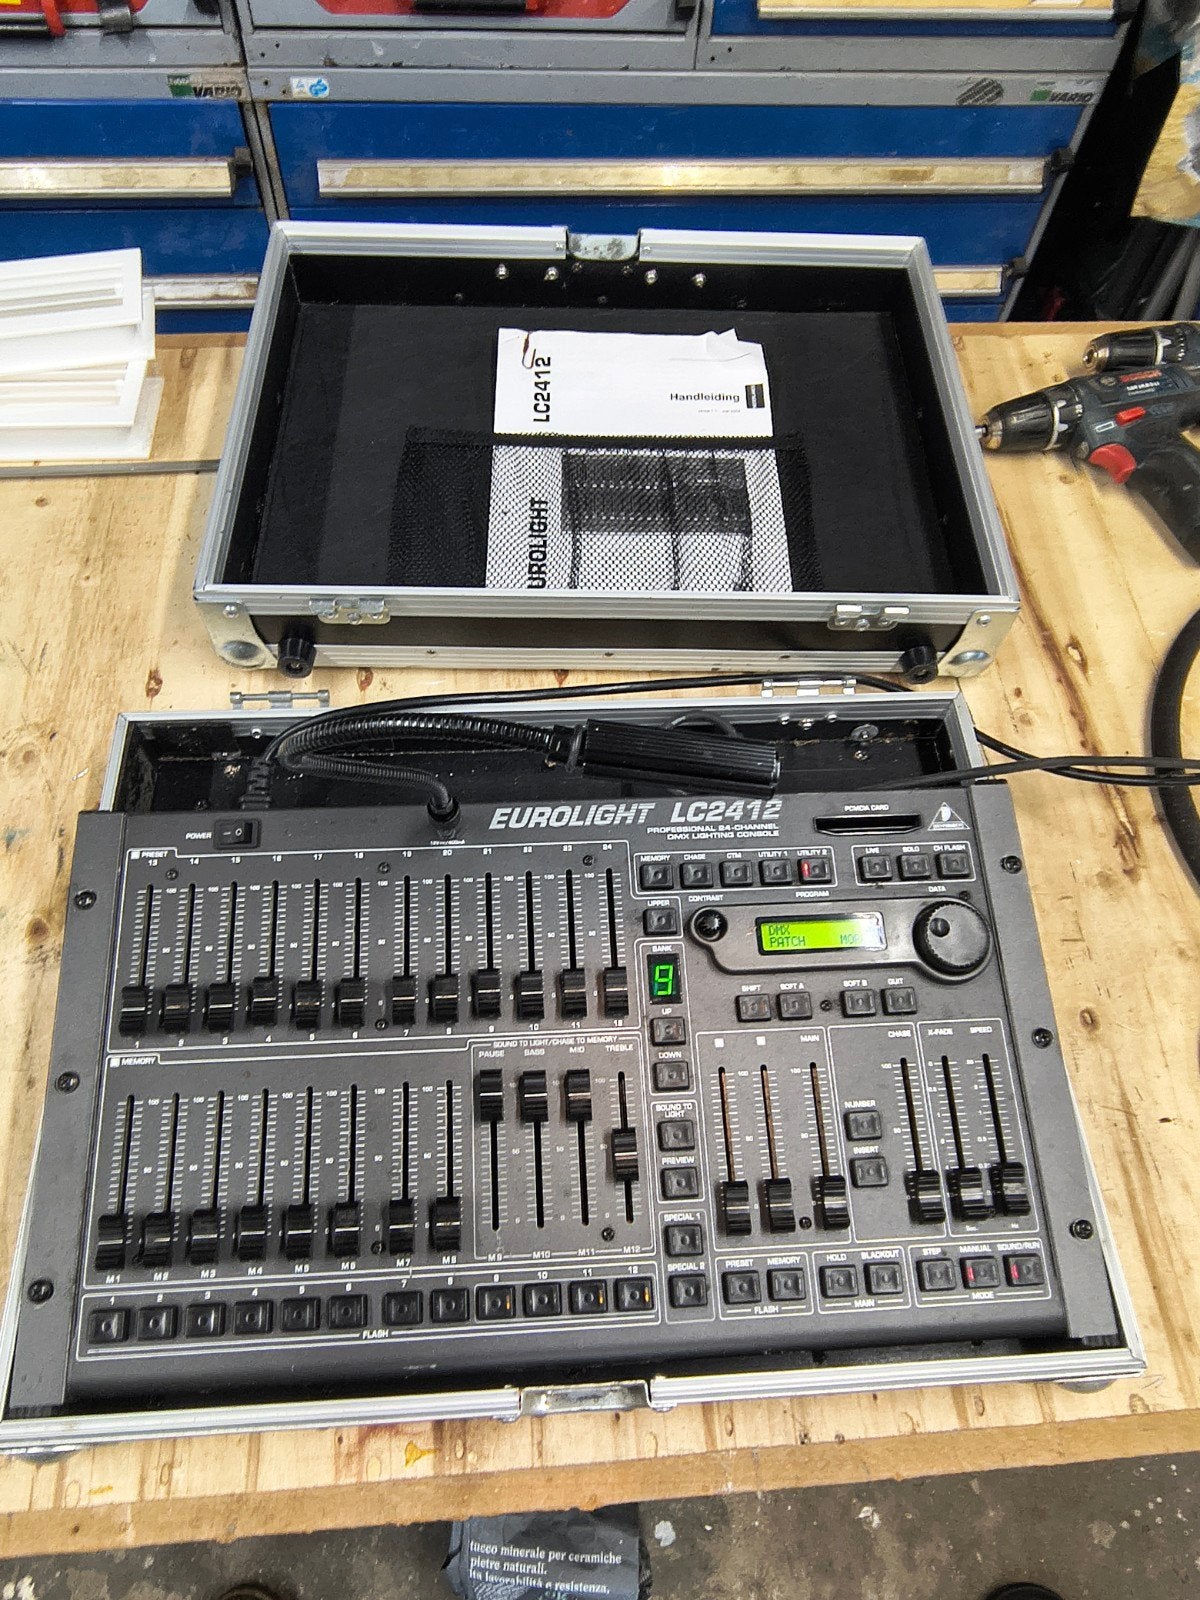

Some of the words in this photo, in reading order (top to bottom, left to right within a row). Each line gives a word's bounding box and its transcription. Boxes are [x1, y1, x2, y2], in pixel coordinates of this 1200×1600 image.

[533, 357, 551, 423] LC2412
[670, 393, 740, 403] Handleiding
[489, 802, 654, 830] EUROLIGHT
[670, 800, 782, 823] LC2412
[647, 825, 716, 834] PROFESSIONAL
[719, 823, 779, 831] 24-CHANNEL
[185, 832, 212, 840] POWER
[737, 830, 779, 838] CONSOLE
[769, 925, 790, 935] DMX
[770, 936, 806, 948] PATCH
[654, 965, 673, 996] 9
[587, 1035, 617, 1044] MEMORY
[605, 1044, 634, 1052] TREBLE
[479, 1050, 504, 1058] PAUSE
[121, 1057, 156, 1065] MEMORY
[844, 1100, 876, 1108] NUMBER
[664, 1110, 685, 1118] LIGHT
[664, 1213, 694, 1221] SPECIAL
[578, 1248, 595, 1256] M11
[623, 1246, 641, 1254] M12
[922, 1248, 941, 1256] STEP
[959, 1245, 991, 1253] MANUAL
[532, 1251, 551, 1259] M10
[861, 1250, 899, 1260] BLACKOUT
[725, 1259, 754, 1268] PRESET
[767, 1256, 800, 1265] MEMORY
[247, 1267, 263, 1276] M4
[667, 1264, 698, 1272] SPECIAL
[106, 1275, 121, 1284] M1
[972, 1292, 994, 1300] MODE
[754, 1306, 779, 1314] FLASH
[363, 1330, 389, 1339] FLASH
[501, 1544, 545, 1559] minerale
[548, 1550, 566, 1562] per
[569, 1551, 622, 1564] ceramiche
[470, 1556, 500, 1570] pietre
